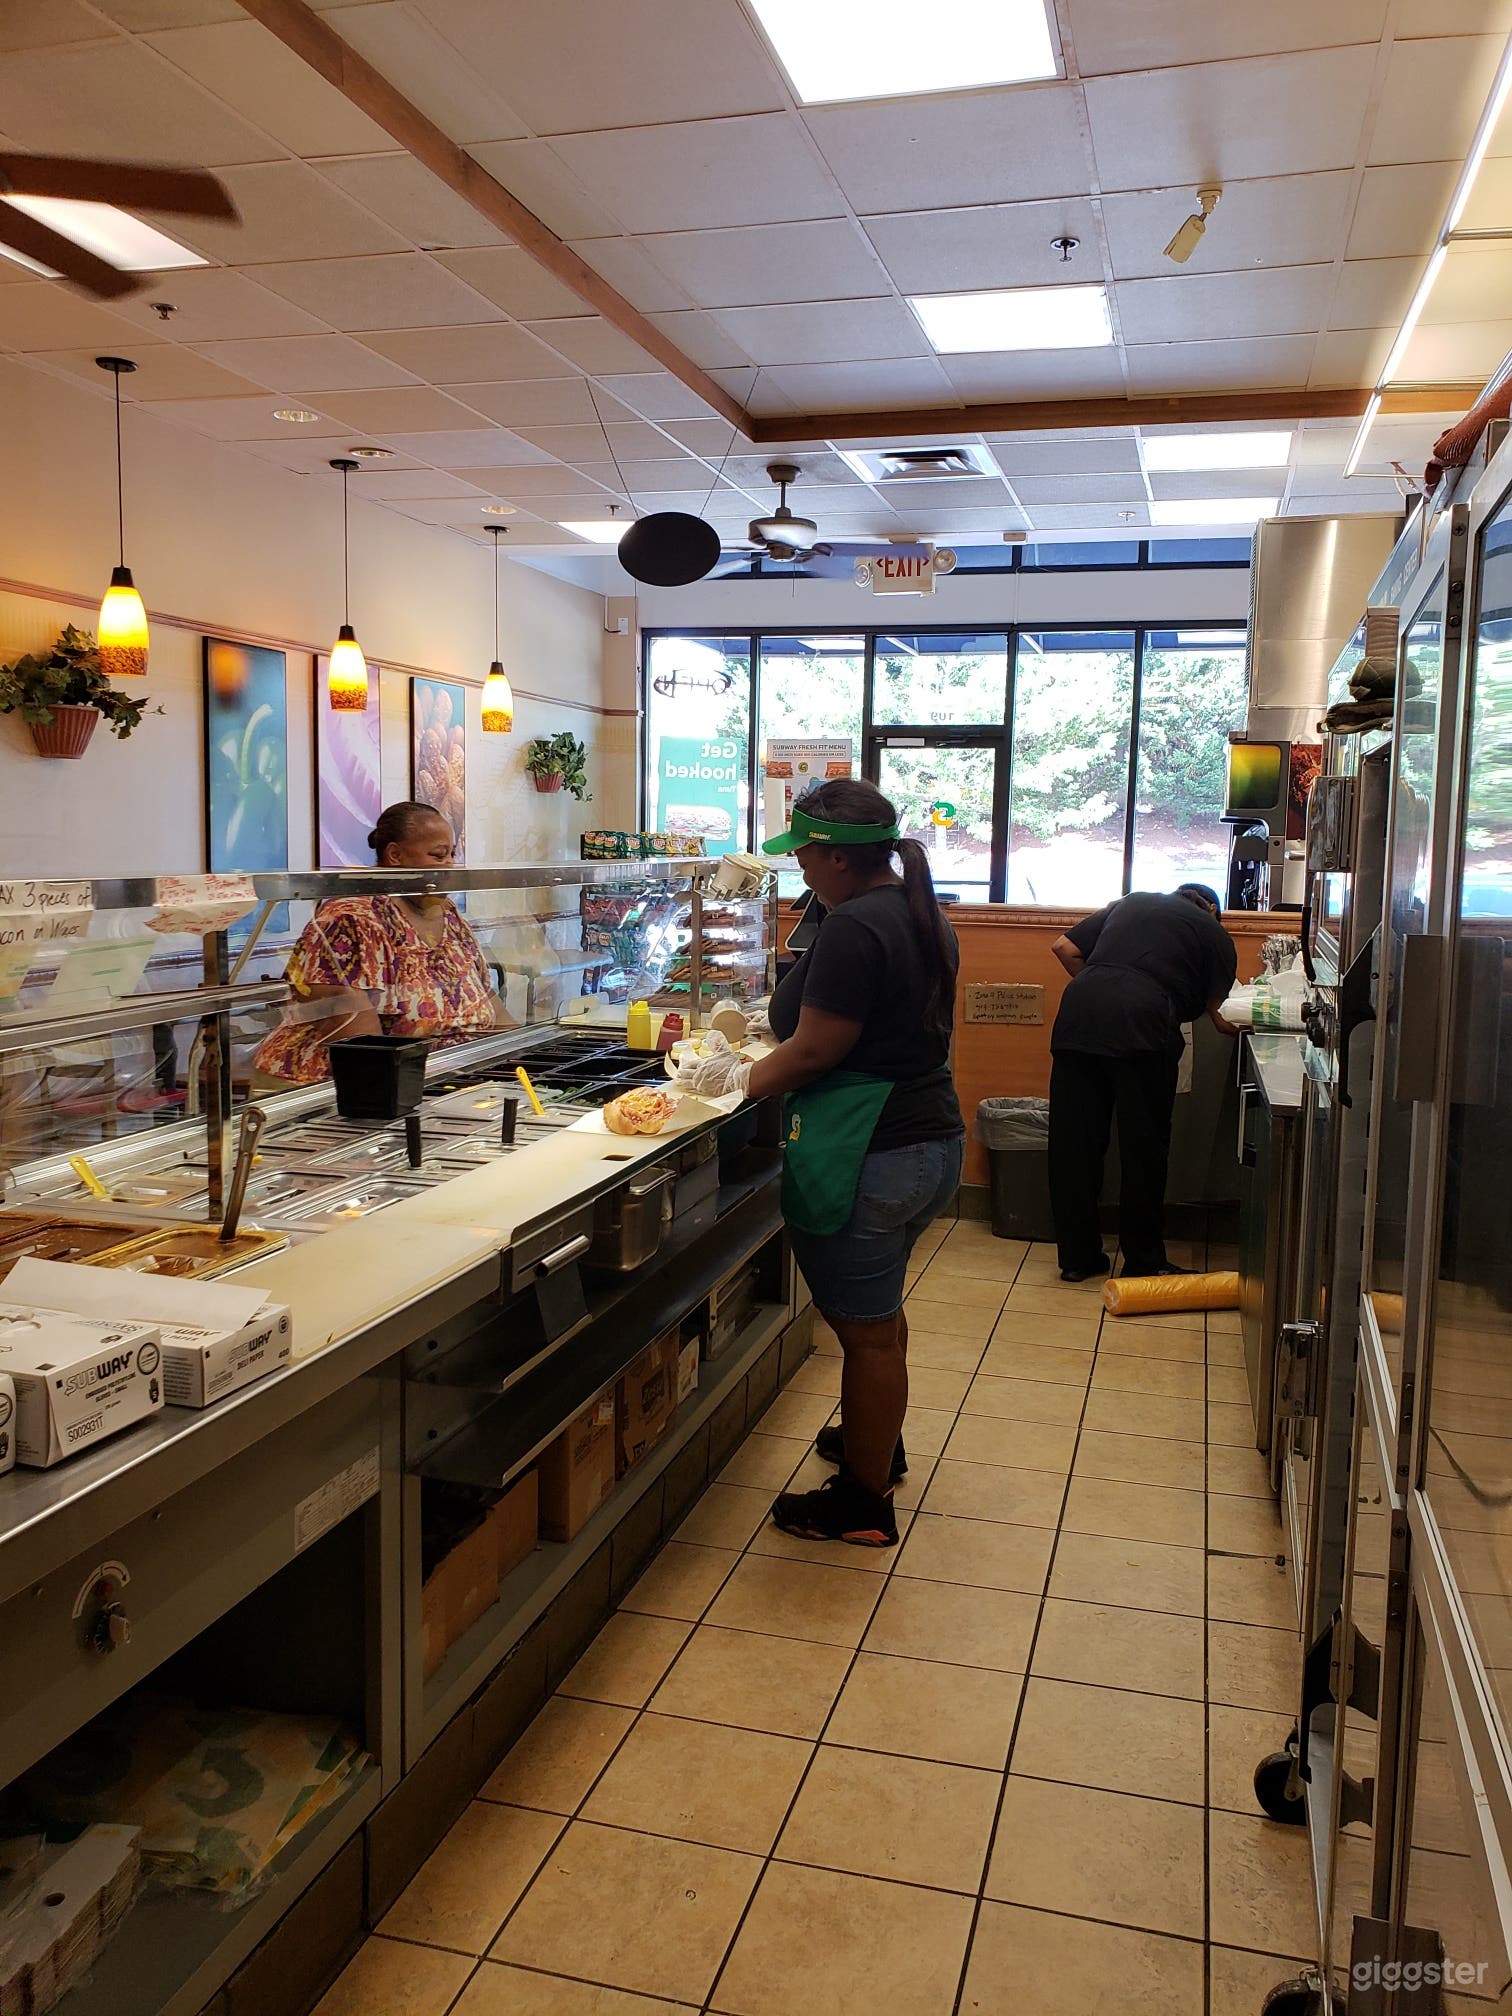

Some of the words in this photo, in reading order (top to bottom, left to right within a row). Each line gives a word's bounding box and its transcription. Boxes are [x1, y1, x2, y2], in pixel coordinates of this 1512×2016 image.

[884, 556, 922, 578] EXIT
[23, 881, 36, 908] 3
[0, 928, 25, 945] con
[64, 1350, 134, 1397] SUBWAY
[67, 1415, 105, 1443] S002931T
